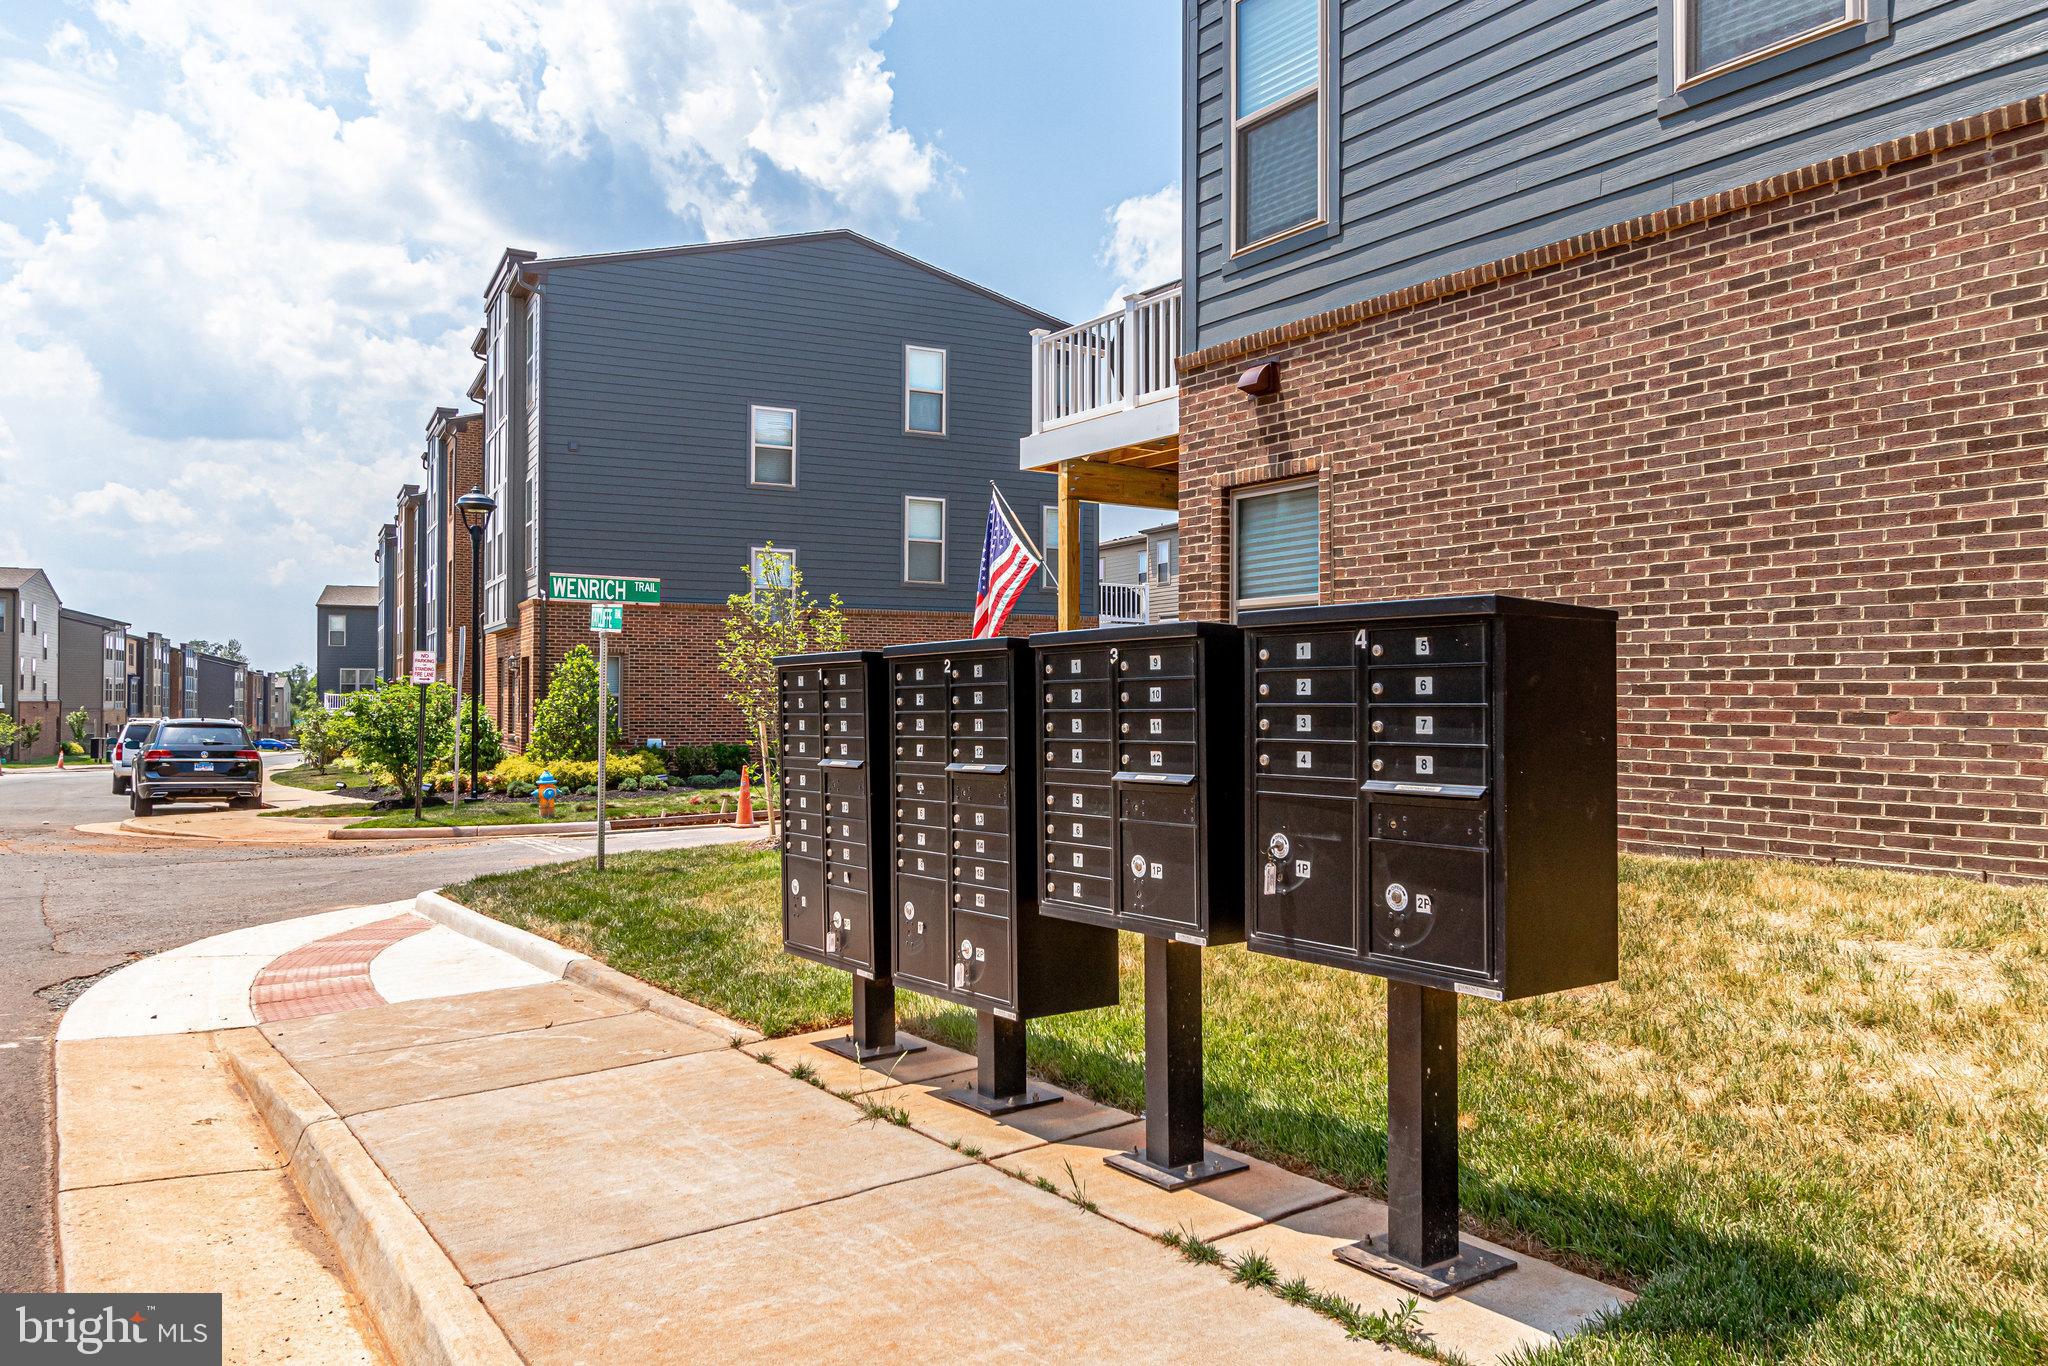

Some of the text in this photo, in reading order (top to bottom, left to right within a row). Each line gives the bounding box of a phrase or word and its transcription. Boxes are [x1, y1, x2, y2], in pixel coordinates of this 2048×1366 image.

[553, 577, 658, 600] WENRICH TRAIL
[1354, 629, 1368, 649] 4
[1420, 640, 1427, 651] 5
[1109, 648, 1119, 664] 3
[1300, 646, 1305, 656] 1
[944, 659, 951, 673] 2
[1074, 662, 1078, 671] 1
[1153, 657, 1158, 667] 9
[817, 668, 822, 680] 1
[1300, 682, 1306, 692] 2
[1420, 680, 1427, 691] 6
[1074, 691, 1079, 700] 2
[1152, 689, 1160, 698] 10
[1075, 721, 1080, 730] 3
[1152, 722, 1160, 731] 11
[1300, 718, 1306, 728] 3
[1421, 719, 1427, 730] 7
[1075, 752, 1080, 760] 4
[1152, 754, 1160, 763] 12
[1300, 754, 1306, 764] 4
[1421, 759, 1427, 770] 8
[1075, 796, 1080, 805] 5
[1076, 826, 1080, 834] 6
[1076, 855, 1081, 864] 7
[1153, 866, 1162, 875] 1P
[1297, 863, 1309, 874] 1P
[1076, 885, 1081, 893] 8
[1417, 897, 1430, 909] 2P
